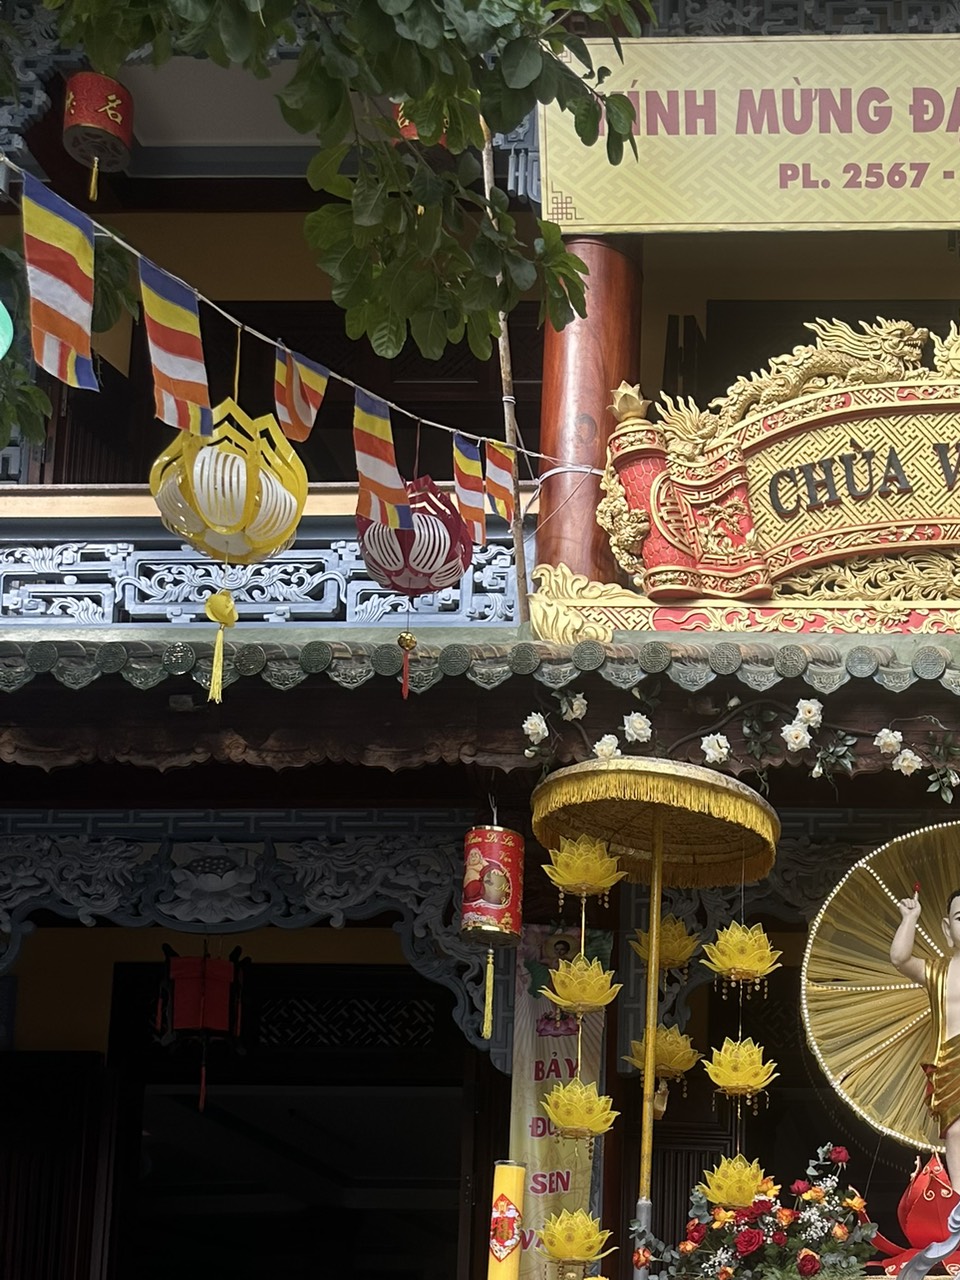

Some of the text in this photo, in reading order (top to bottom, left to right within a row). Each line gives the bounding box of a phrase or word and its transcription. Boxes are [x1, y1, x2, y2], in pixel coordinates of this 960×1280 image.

[597, 79, 717, 137] ÍNH
[735, 77, 893, 135] MỪNG
[779, 162, 831, 189] PL.
[842, 162, 931, 189] 2567
[769, 438, 913, 522] CHÙA
[534, 1051, 579, 1082] BẢY
[530, 1170, 571, 1195] SEN
